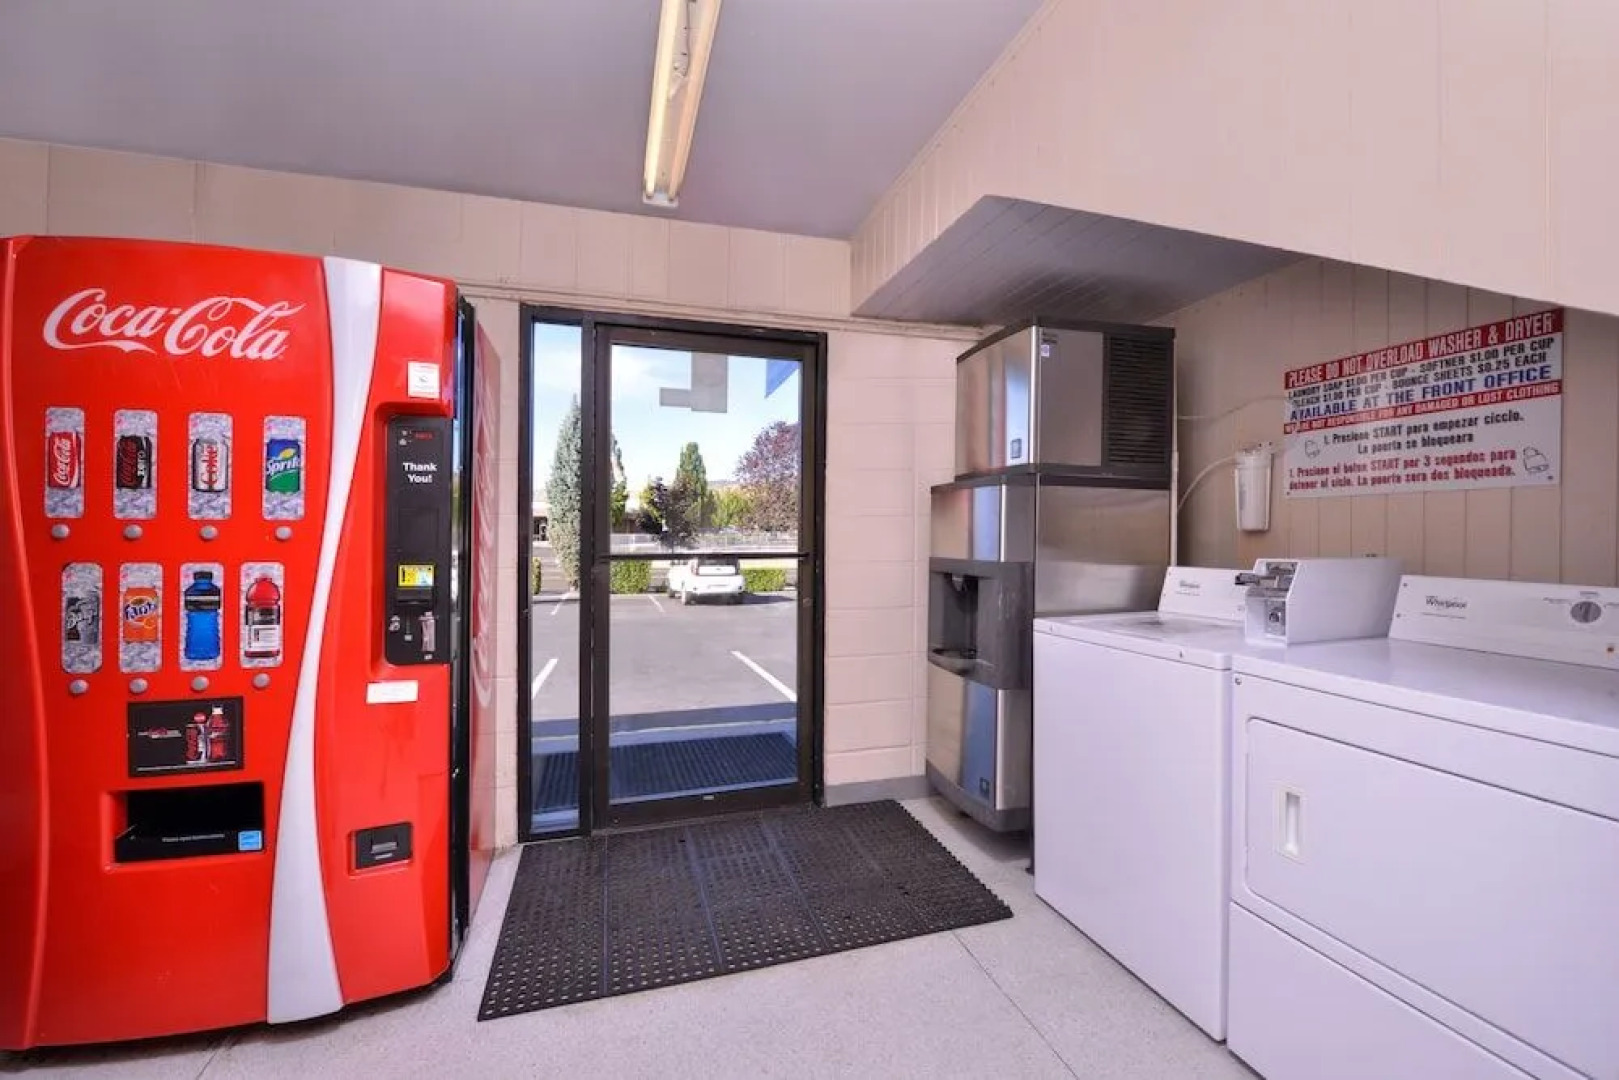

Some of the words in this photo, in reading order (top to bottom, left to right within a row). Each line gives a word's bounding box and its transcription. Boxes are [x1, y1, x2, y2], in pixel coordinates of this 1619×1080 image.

[43, 288, 305, 360] Coca-Cola
[1290, 365, 1324, 388] PLEASE
[1343, 356, 1363, 377] NOT
[1366, 342, 1424, 371] OVERLOAD
[1428, 328, 1482, 358] WASHER
[1488, 324, 1499, 344] &
[1505, 312, 1552, 342] DRYER
[1504, 343, 1525, 356] PER
[1530, 337, 1555, 351] CUP
[1515, 352, 1547, 366] EACH
[1290, 400, 1357, 421] AVAILABLE
[1363, 395, 1378, 408] AT
[1387, 389, 1415, 403] THE
[1422, 379, 1476, 399] FRONT
[1484, 365, 1552, 388] OFFICE
[1477, 391, 1502, 404] LOST
[1373, 424, 1402, 439] START
[1406, 424, 1428, 436] para
[402, 462, 438, 472] Thank
[1371, 458, 1400, 471] START
[1424, 455, 1431, 466] 3
[1491, 449, 1516, 463] para
[407, 473, 433, 483] You!
